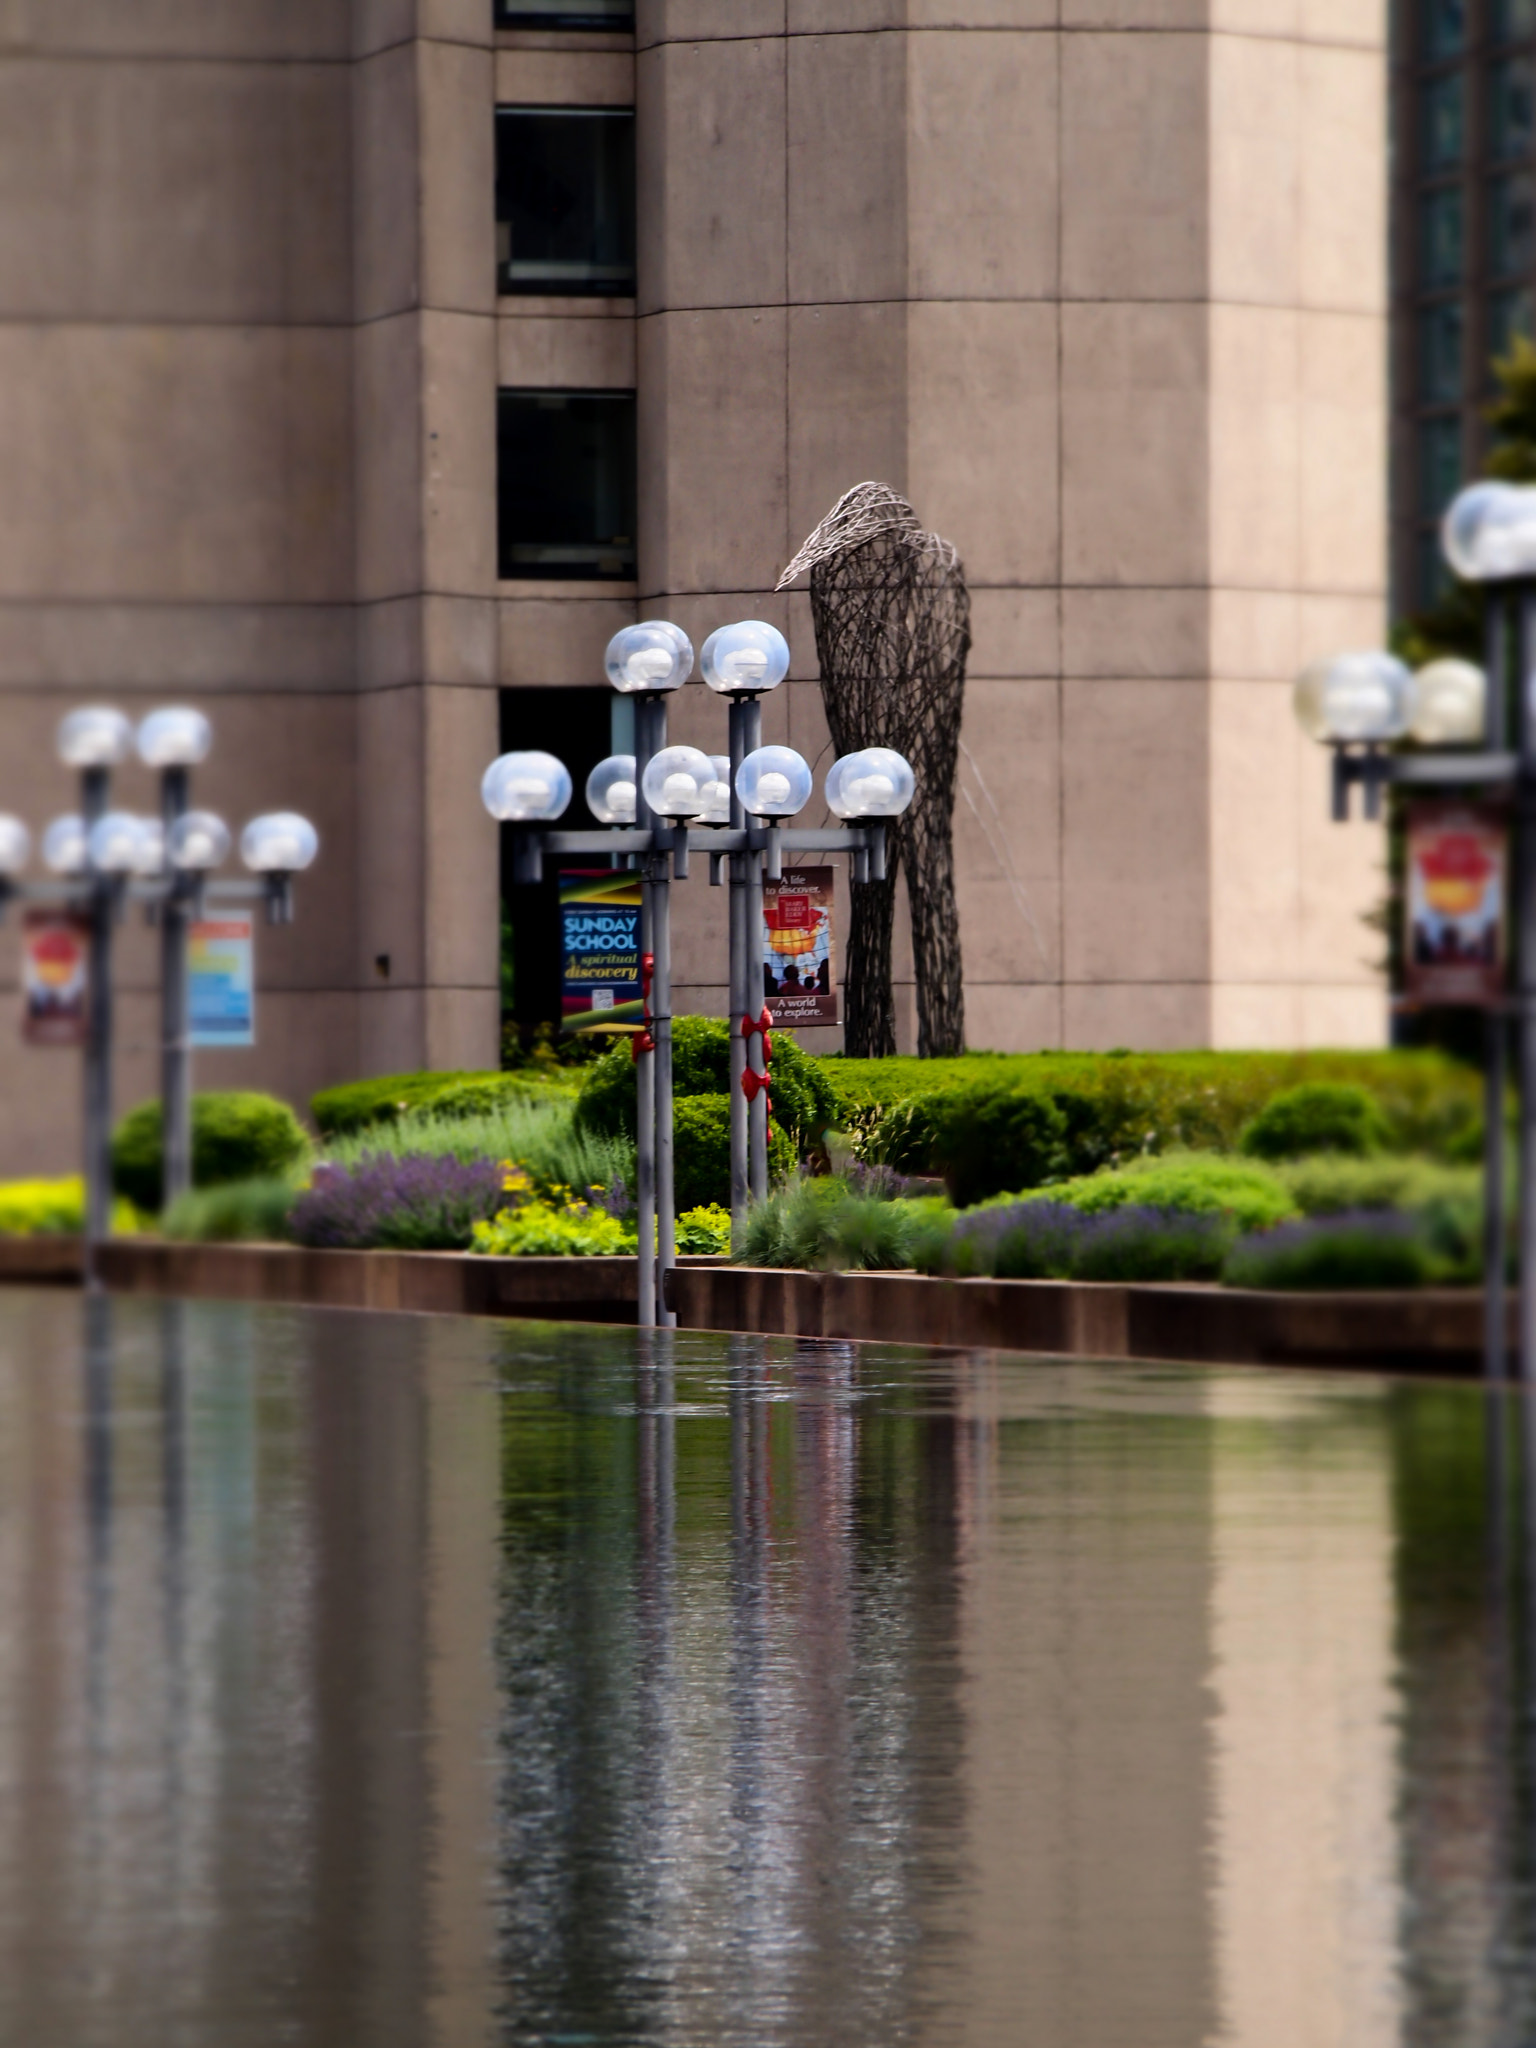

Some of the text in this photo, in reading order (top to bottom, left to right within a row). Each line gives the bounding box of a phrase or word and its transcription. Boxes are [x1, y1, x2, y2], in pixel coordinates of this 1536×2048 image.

[780, 875, 806, 885] A life
[766, 885, 821, 895] to discover.
[565, 917, 637, 932] SUNDAY
[565, 934, 637, 950] SCHOOL
[567, 954, 637, 966] A spiritual
[565, 965, 638, 980] discovery
[778, 997, 816, 1008] A world
[772, 1007, 823, 1019] to explore.
